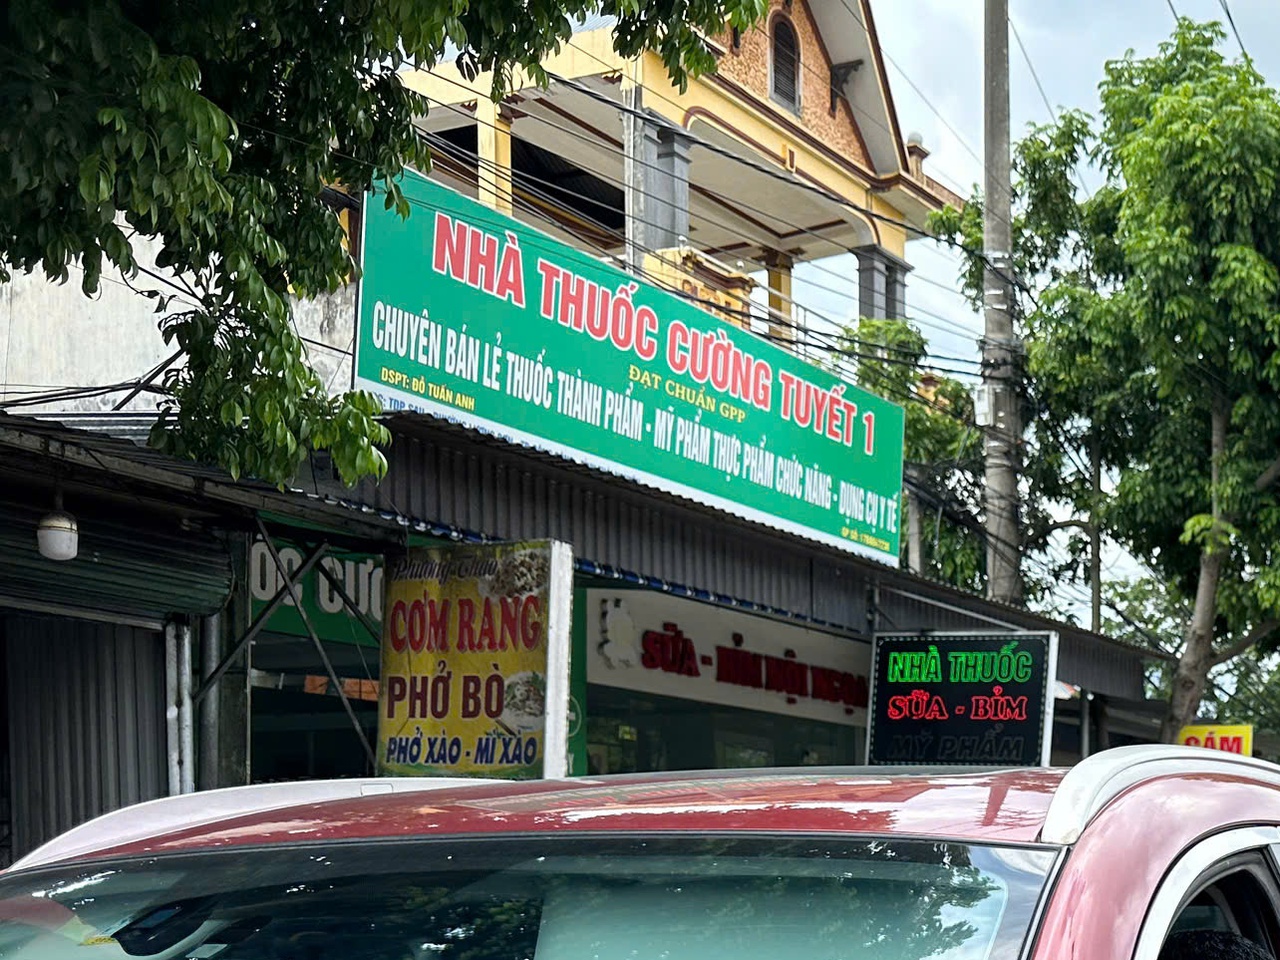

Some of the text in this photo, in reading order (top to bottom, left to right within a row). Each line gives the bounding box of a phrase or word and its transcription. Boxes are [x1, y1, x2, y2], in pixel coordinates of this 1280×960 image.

[433, 212, 875, 456] NHÀ THUỐC CƯỜNG TUYẾT 1
[372, 300, 442, 369] CHUYÊN
[445, 324, 480, 384] BÁN
[483, 331, 503, 391] LẺ
[506, 349, 553, 409] THUỐC
[557, 368, 602, 427] THÀNH
[604, 381, 644, 441] PHẨM
[653, 405, 675, 452] MỸ
[675, 408, 711, 465] PHẨM
[713, 430, 741, 482] THỰC
[743, 433, 775, 489] PHẨM
[776, 454, 803, 499] CHỨC
[804, 463, 831, 511] NĂNG
[381, 366, 410, 389] DSPT:
[455, 392, 475, 411] ANH
[628, 364, 747, 424] ĐẠT CHUẨN GPP
[389, 590, 543, 653] CƠM RANG
[387, 660, 505, 719] PHỞ BÒ
[887, 641, 1033, 683] NHÀ THUỐC
[887, 689, 949, 720] SỮA
[970, 685, 1028, 720] BỈM
[385, 727, 424, 764] PHỞ
[424, 729, 462, 764] XÀO
[498, 729, 538, 765] XÀO
